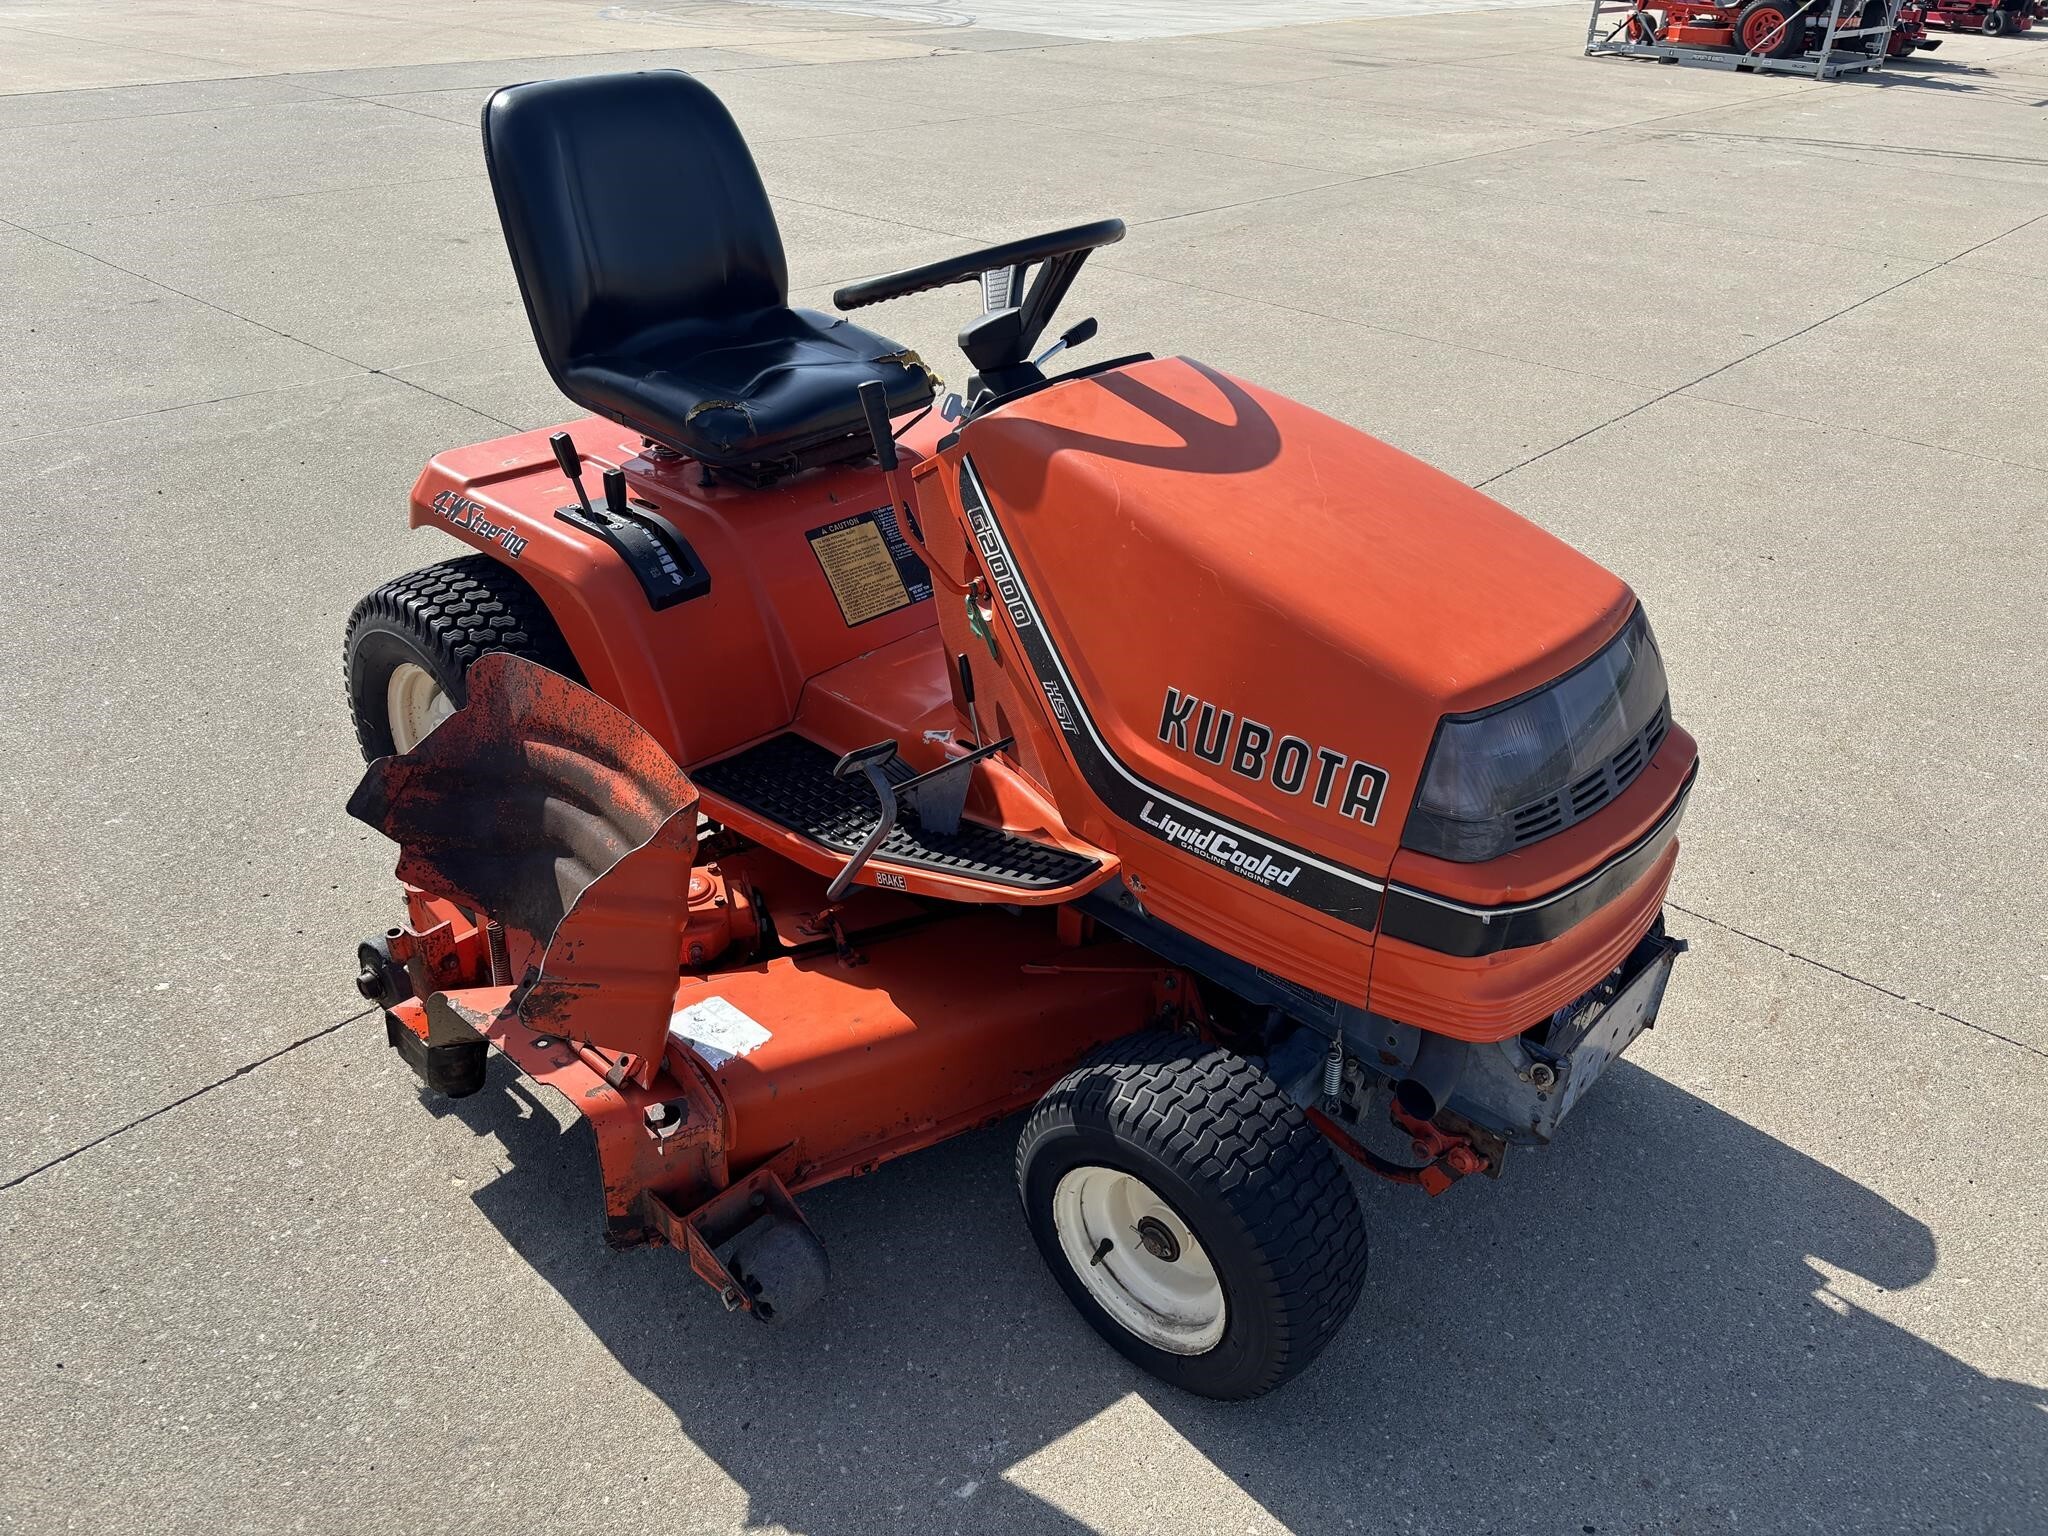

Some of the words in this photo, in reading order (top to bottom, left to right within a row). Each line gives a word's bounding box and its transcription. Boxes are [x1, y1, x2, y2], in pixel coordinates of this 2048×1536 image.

[828, 517, 860, 532] CAUTION
[967, 506, 1031, 628] G2000
[1042, 680, 1079, 736] HST
[1157, 685, 1390, 827] KUBOTA
[876, 872, 906, 888] BRAKE
[1180, 841, 1227, 867] GASOLINE
[1233, 866, 1271, 886] ENGINE
